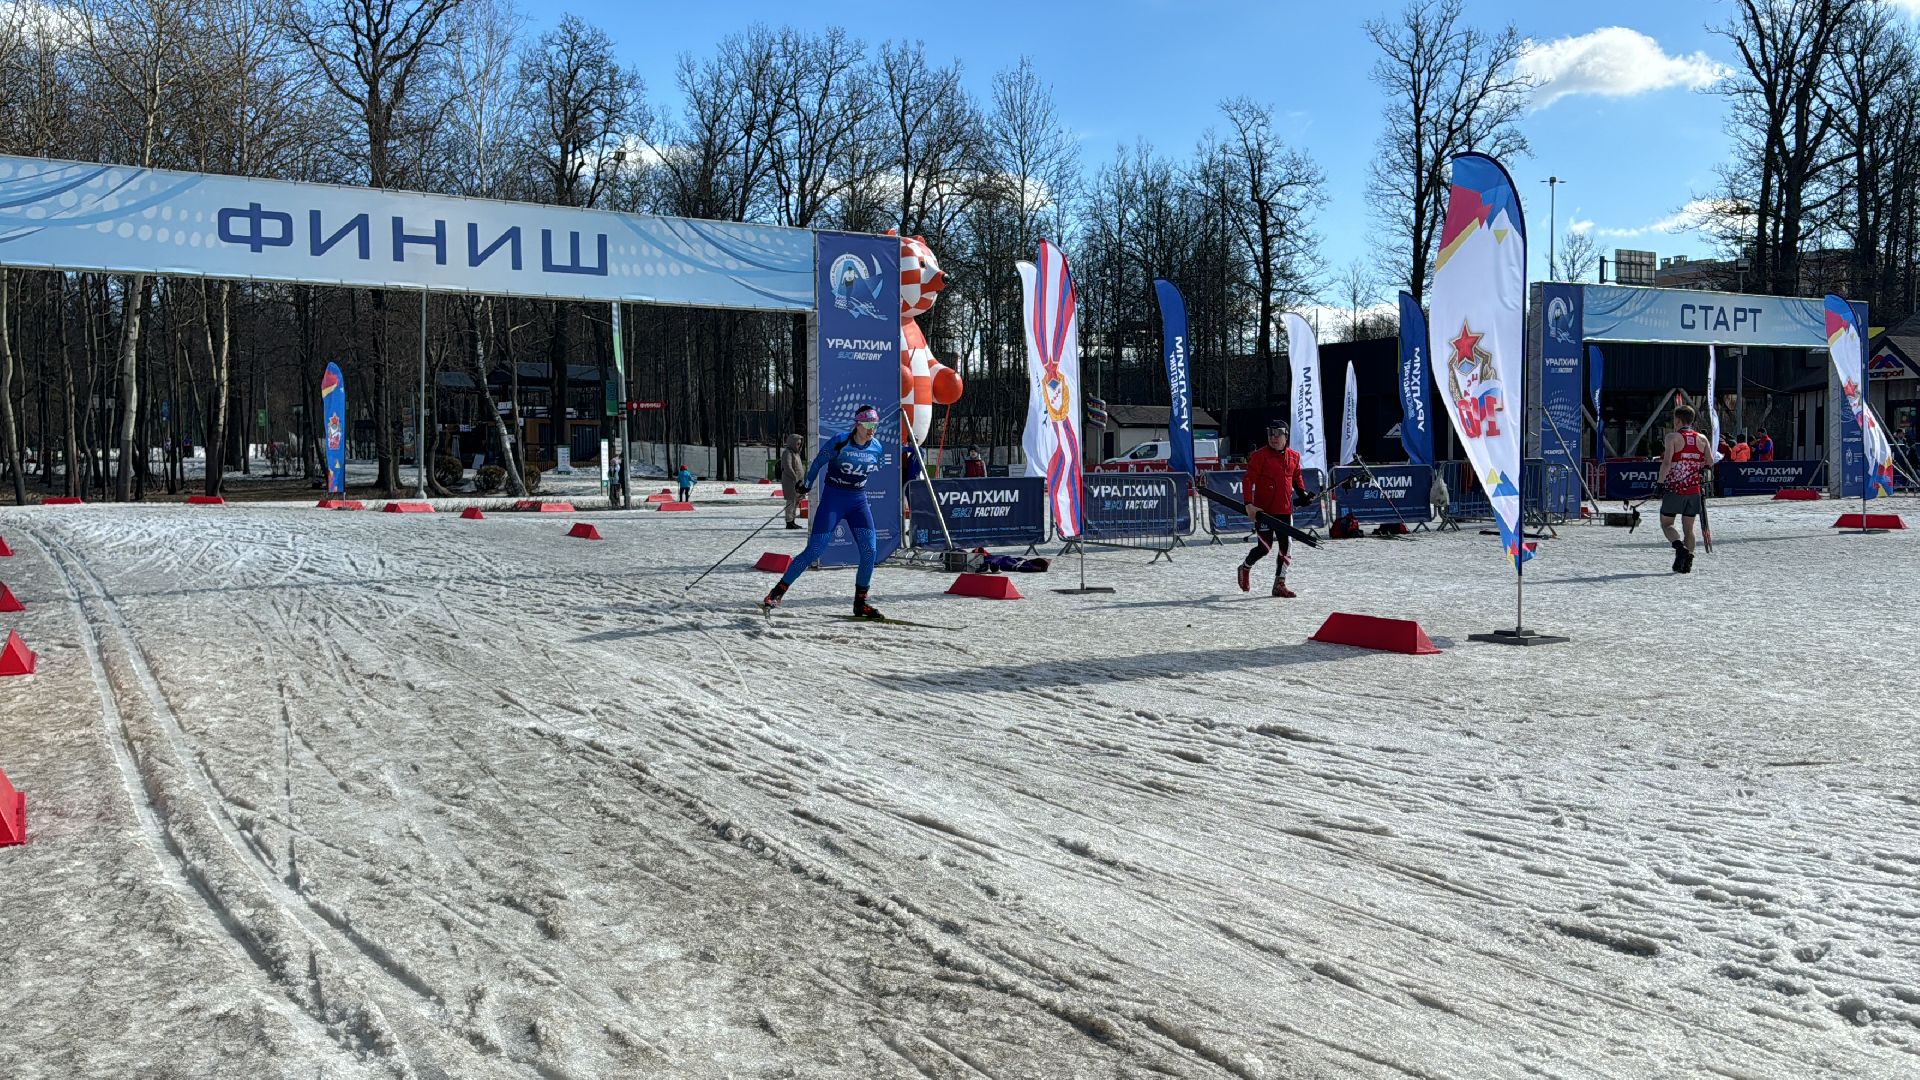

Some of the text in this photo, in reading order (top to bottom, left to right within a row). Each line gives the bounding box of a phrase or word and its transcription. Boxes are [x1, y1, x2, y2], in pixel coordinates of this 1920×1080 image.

[217, 201, 609, 277] ФИНИШ
[1680, 303, 1763, 333] СТАРТ
[826, 338, 892, 352] УРАЛХИМ
[853, 351, 882, 361] FACTORY
[1545, 358, 1579, 367] УРАЛХИМ
[1739, 467, 1803, 476] УРАЛХИМ
[939, 489, 1019, 506] УРАЛХИМ
[1090, 484, 1167, 499] УРАЛХИМ
[1125, 499, 1159, 510] FACTORY
[974, 506, 1011, 518] FACTORY
